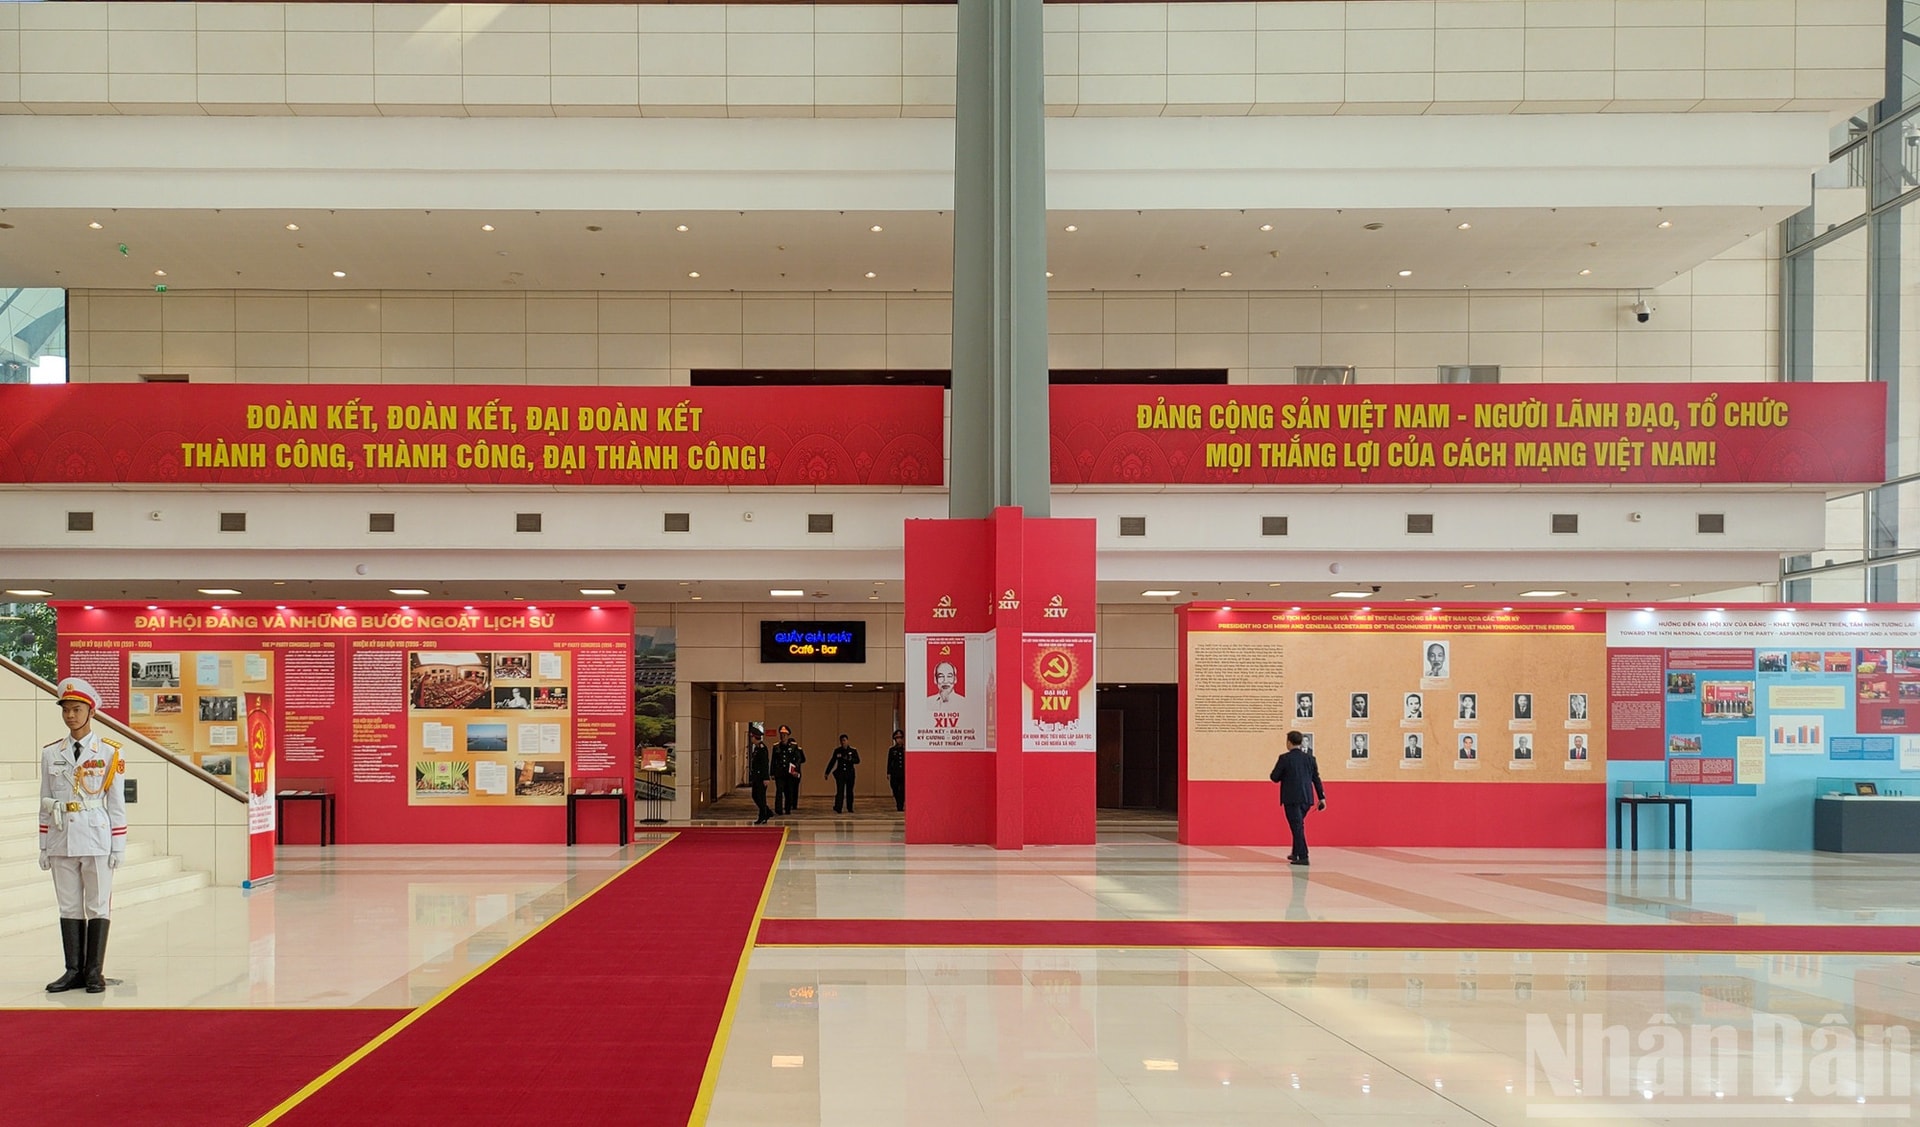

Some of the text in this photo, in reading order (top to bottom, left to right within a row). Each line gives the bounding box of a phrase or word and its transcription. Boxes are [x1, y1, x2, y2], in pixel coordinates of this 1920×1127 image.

[246, 397, 703, 436] ĐOÀN KẾT, ĐOÀN KẾT, ĐẠI ĐOÀN KẾT
[1135, 397, 1202, 429] ĐẢNG
[1209, 399, 1273, 434] CỘNG
[1281, 396, 1331, 429] SẢN
[1337, 399, 1387, 434] VIỆT
[1394, 404, 1450, 429] NAM
[1474, 397, 1548, 428] NGƯỜI
[1556, 398, 1618, 427] LÃNH
[1625, 403, 1679, 432] ĐẠO,
[1687, 392, 1718, 427] TỔ
[1724, 397, 1789, 427] CHỨC
[181, 438, 766, 474] THÀNH CÔNG, THÀNH CÔNG, ĐẠI THÀNH CÔNG!
[1206, 434, 1716, 473] MỌI THẮNG LỢI CỦA CÁCH MẠNG VIỆT NAM!
[998, 600, 1020, 609] XIV
[932, 608, 957, 618] XIV
[1043, 608, 1068, 618] XIV
[134, 612, 555, 631] ĐẠI HỘI ĐẢNG VÀ NHỮNG BƯỚC NGOẶT LỊCH SỬ
[789, 644, 814, 654] Café
[821, 644, 838, 654] Bar
[1040, 696, 1071, 710] XIV
[935, 718, 959, 728] XIV
